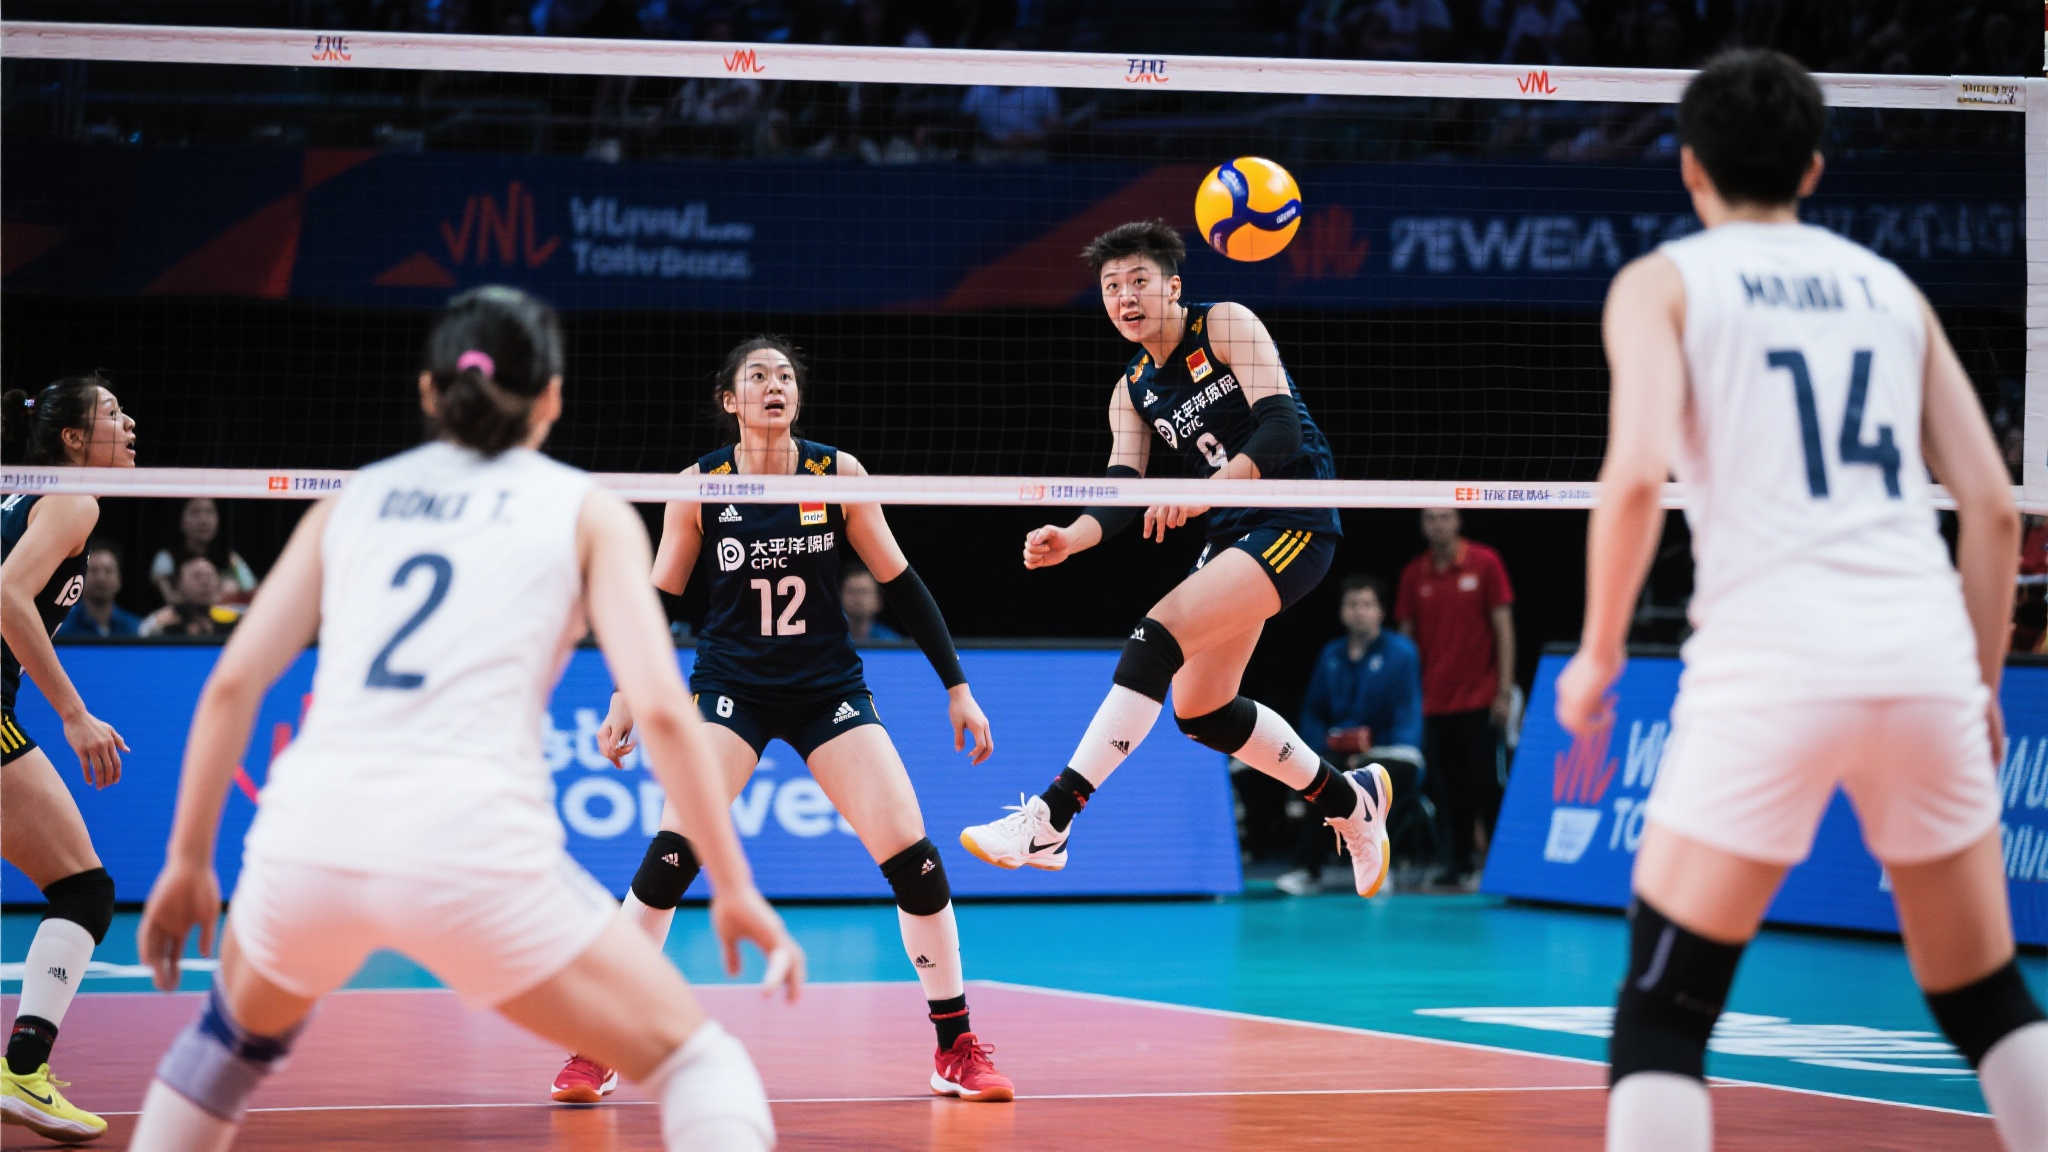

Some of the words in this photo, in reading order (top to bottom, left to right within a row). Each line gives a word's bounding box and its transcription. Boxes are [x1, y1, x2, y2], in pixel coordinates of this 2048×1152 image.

[442, 181, 561, 267] VNL
[1765, 350, 1902, 498] 14
[750, 575, 807, 637] 12
[751, 557, 788, 570] CPIC
[364, 552, 454, 690] 2
